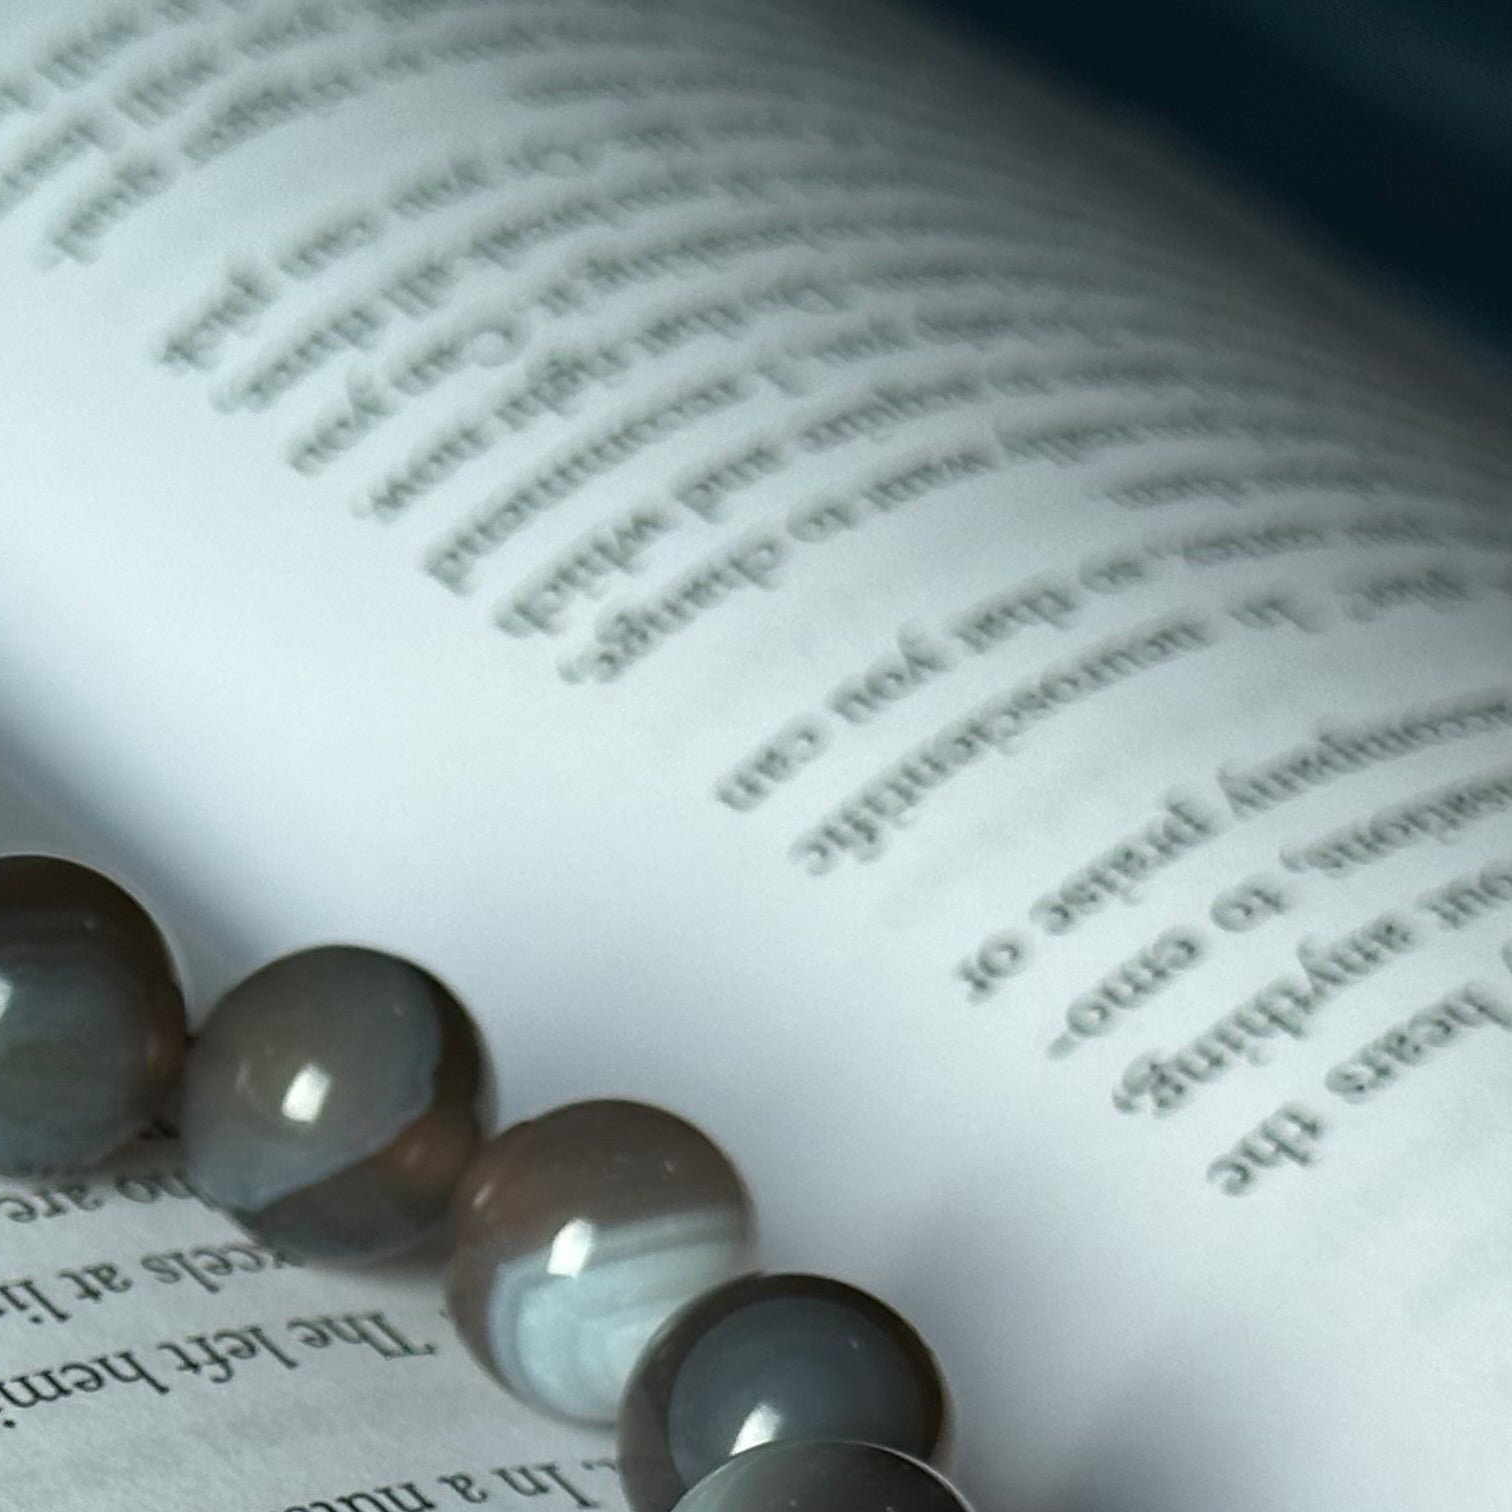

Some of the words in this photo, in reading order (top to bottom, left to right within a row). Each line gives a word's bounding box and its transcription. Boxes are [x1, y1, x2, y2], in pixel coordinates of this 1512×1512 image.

[554, 536, 791, 688] change,
[826, 628, 952, 727] you
[711, 719, 831, 816] can
[786, 619, 1212, 880] neuroscientific
[1026, 798, 1220, 939] praise
[1208, 874, 1287, 935] to
[950, 930, 1028, 1006] or
[1045, 928, 1205, 1062] emo-
[1110, 914, 1416, 1125] anything,
[1204, 1105, 1324, 1199] the
[56, 1261, 134, 1307] at
[157, 1325, 298, 1383] left
[286, 1310, 438, 1362] The
[436, 1473, 489, 1505] a
[488, 1461, 601, 1512] In
